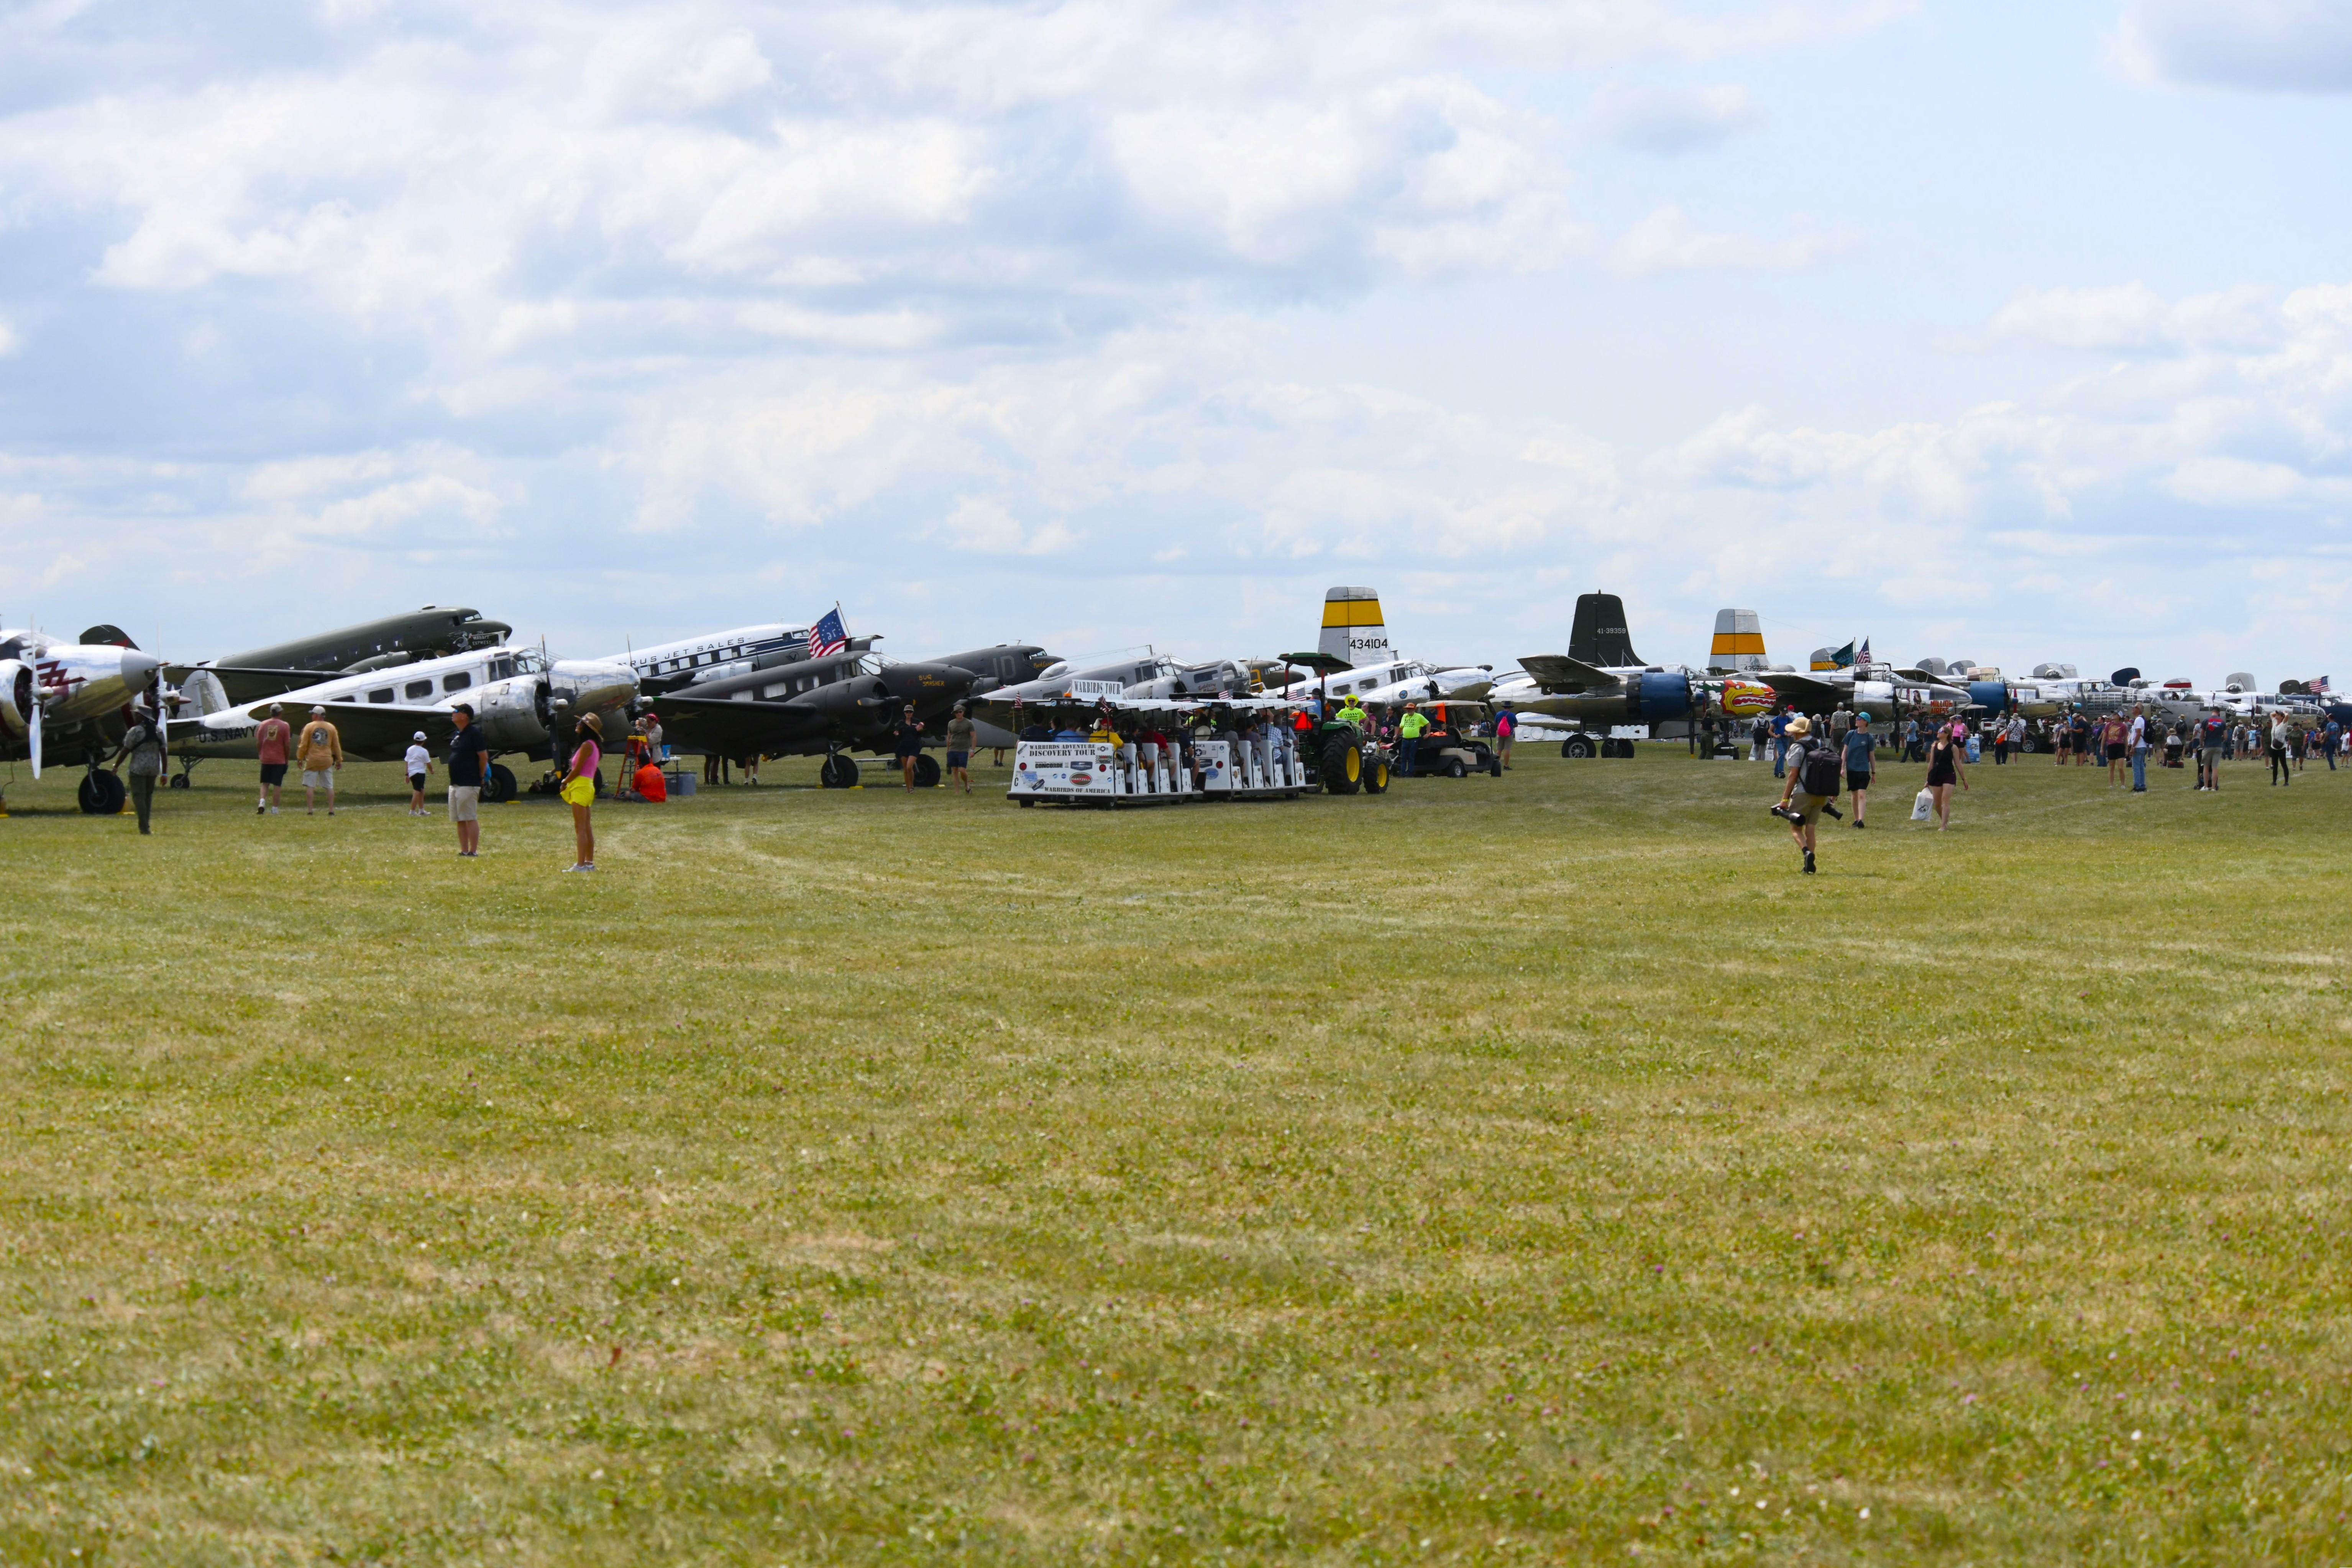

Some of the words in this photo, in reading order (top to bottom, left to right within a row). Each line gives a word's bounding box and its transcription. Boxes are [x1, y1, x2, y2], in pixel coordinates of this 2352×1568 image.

[664, 649, 689, 659] JET
[697, 637, 744, 652] SALES
[1350, 638, 1388, 649] 434104
[1074, 681, 1103, 694] WARBIRDS
[1105, 683, 1120, 694] TOUR
[198, 730, 221, 743] U.S.
[225, 725, 257, 740] NAVY
[1014, 777, 1019, 786] C
